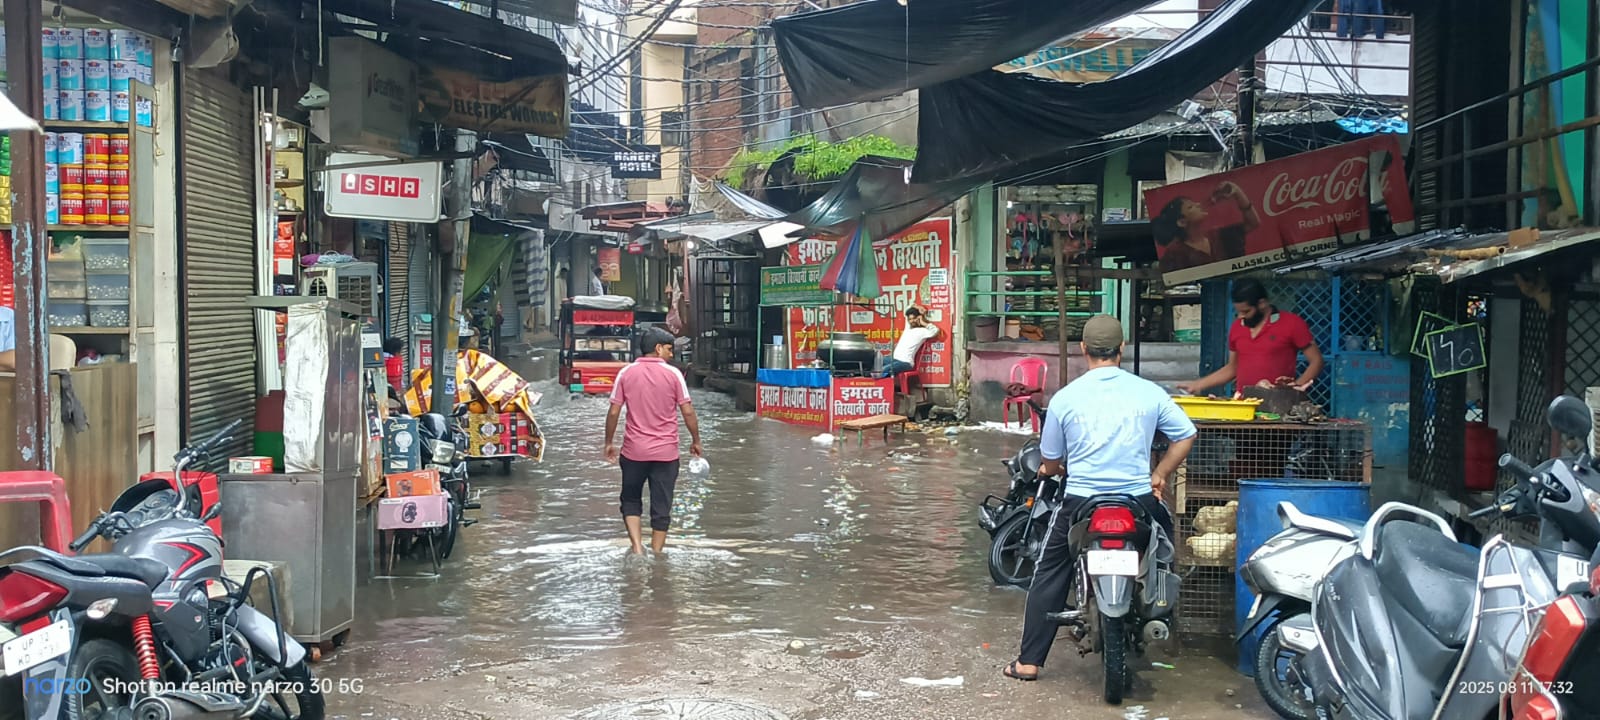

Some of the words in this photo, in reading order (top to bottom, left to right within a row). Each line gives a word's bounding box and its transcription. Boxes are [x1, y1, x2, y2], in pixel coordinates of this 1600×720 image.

[619, 162, 654, 172] HOTEL
[1298, 216, 1324, 230] Real
[1327, 208, 1361, 226] Magic
[1231, 255, 1271, 271] ALASKA
[1303, 240, 1338, 255] CORNE
[840, 386, 884, 402] इमरान
[21, 638, 34, 651] UP
